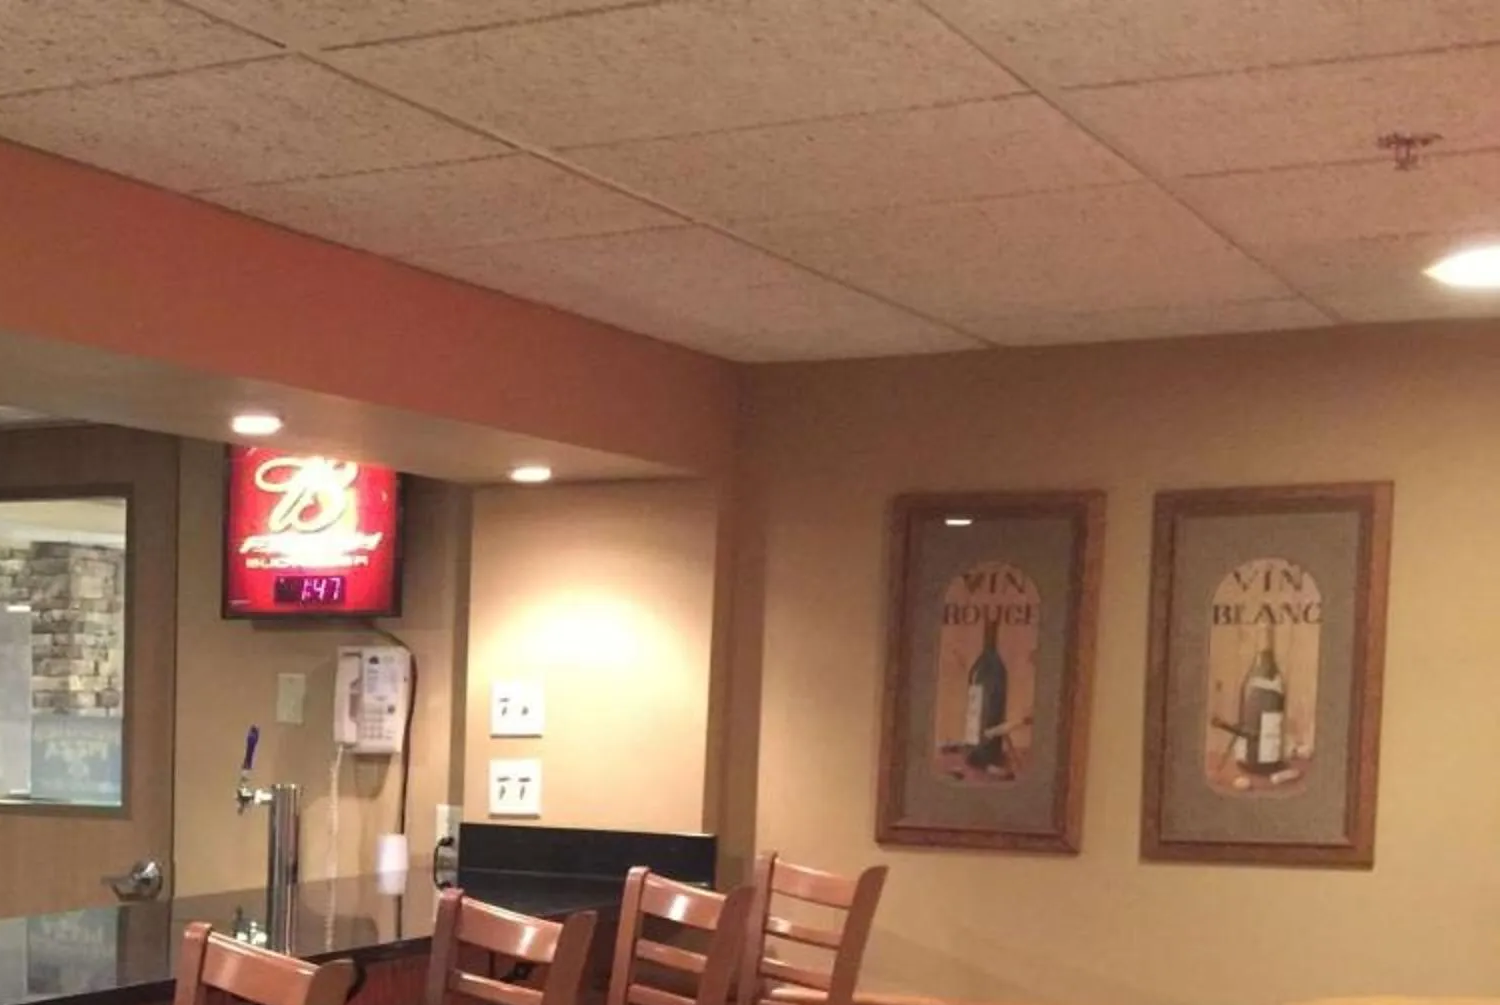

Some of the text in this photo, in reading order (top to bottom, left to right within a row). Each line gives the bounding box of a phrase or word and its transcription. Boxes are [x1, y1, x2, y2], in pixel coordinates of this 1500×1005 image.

[961, 570, 1027, 596] VIN
[1231, 567, 1304, 594] VIN
[942, 601, 1038, 627] ROUGE
[1211, 601, 1323, 627] BLANC
